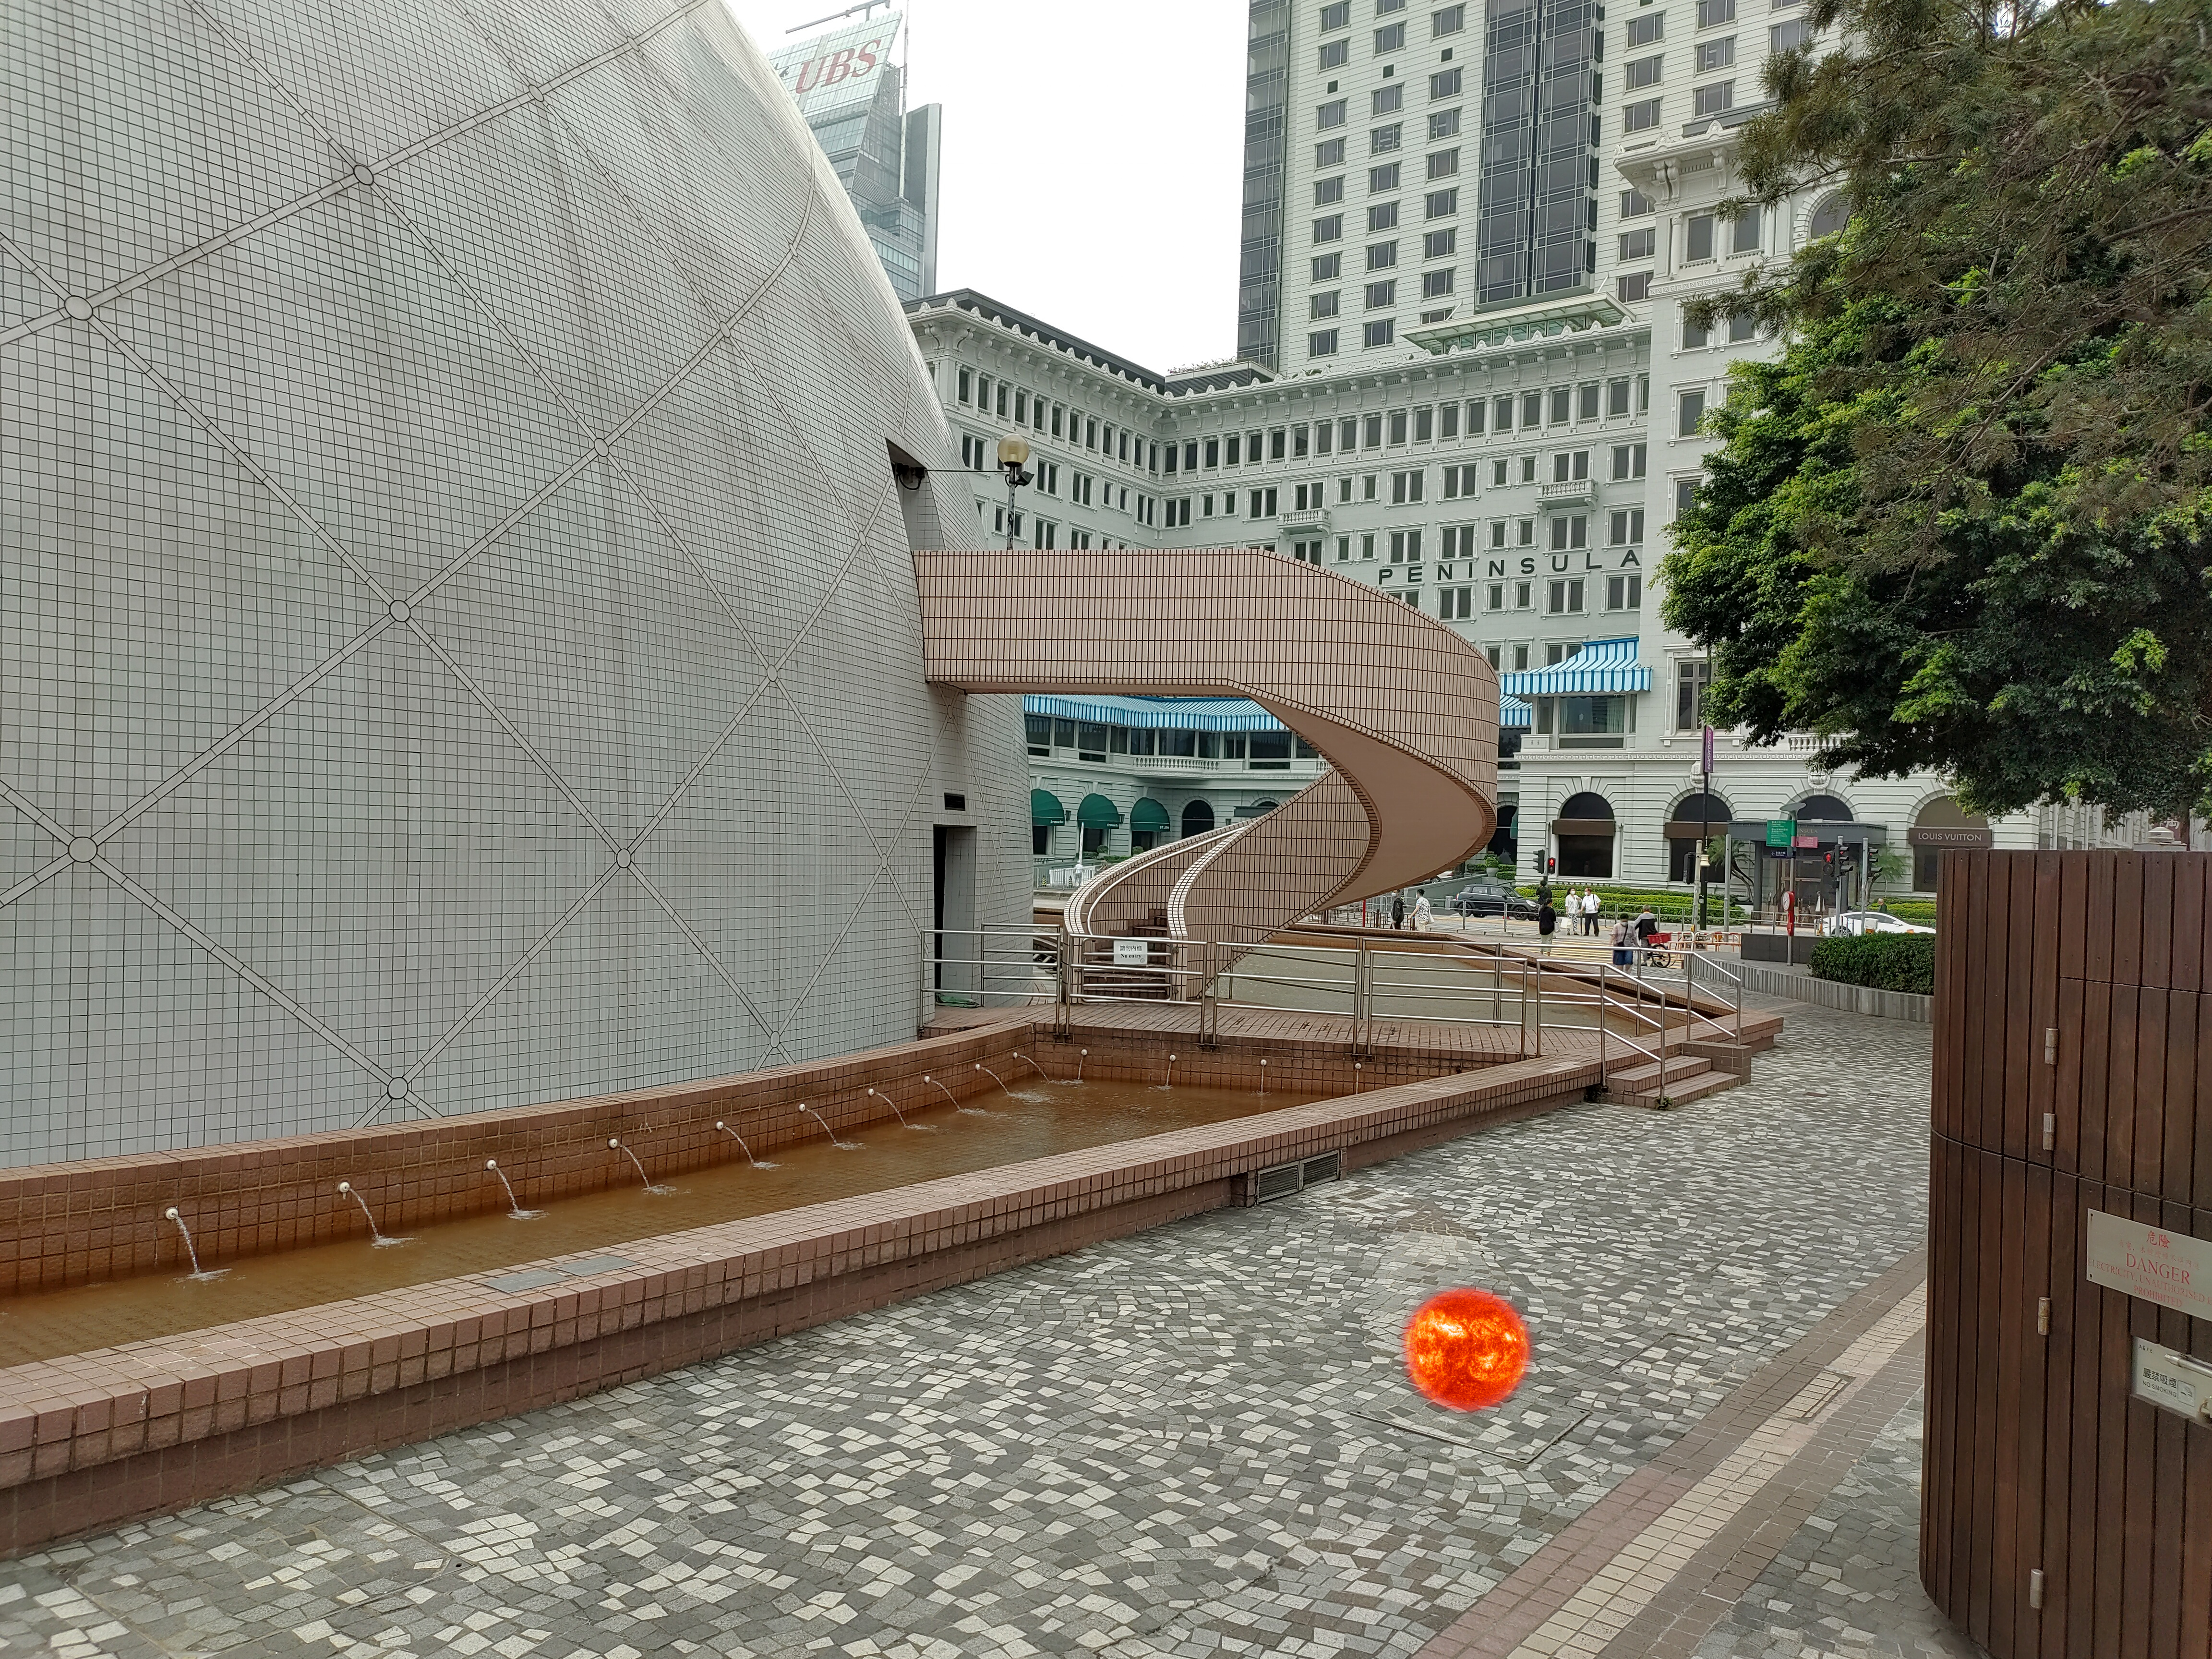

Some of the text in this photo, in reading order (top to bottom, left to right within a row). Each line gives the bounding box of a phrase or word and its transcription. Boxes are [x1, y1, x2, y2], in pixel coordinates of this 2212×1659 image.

[795, 39, 882, 94] UBS
[1379, 549, 1641, 585] PENINSULA
[1918, 832, 1982, 842] LOUIS VUITTON
[2146, 1230, 2171, 1249] 危險
[2126, 1252, 2190, 1286] DANGER
[2134, 1285, 2182, 1308] PROHIBITED
[2140, 1274, 2205, 1303] UNAUTHORISED
[2143, 1367, 2177, 1389] 嚴禁吸煙
[2152, 1383, 2176, 1397] SMOKING
